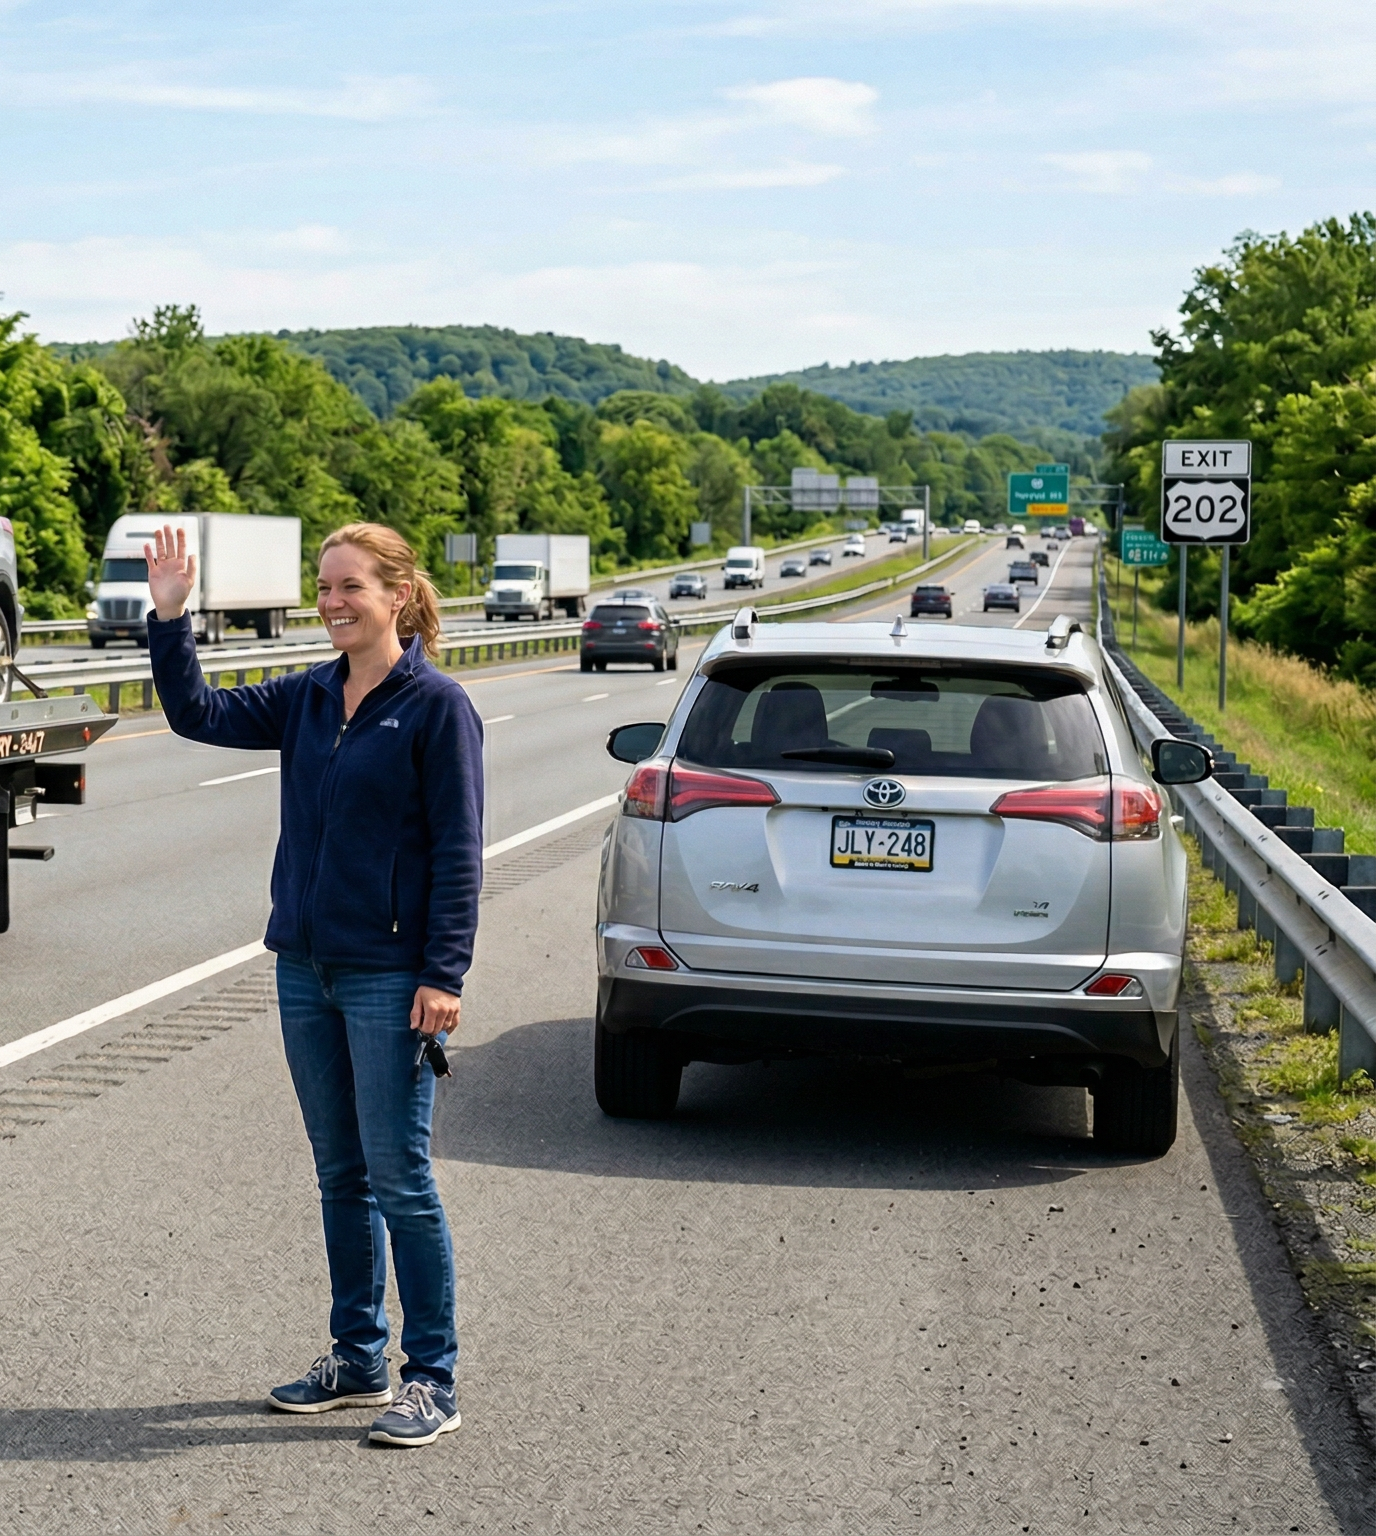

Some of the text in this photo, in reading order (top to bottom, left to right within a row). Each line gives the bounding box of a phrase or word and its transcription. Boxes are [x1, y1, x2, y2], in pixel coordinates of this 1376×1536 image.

[1181, 450, 1233, 468] EXIT
[1171, 494, 1238, 524] 202
[837, 829, 926, 857] JLY-248
